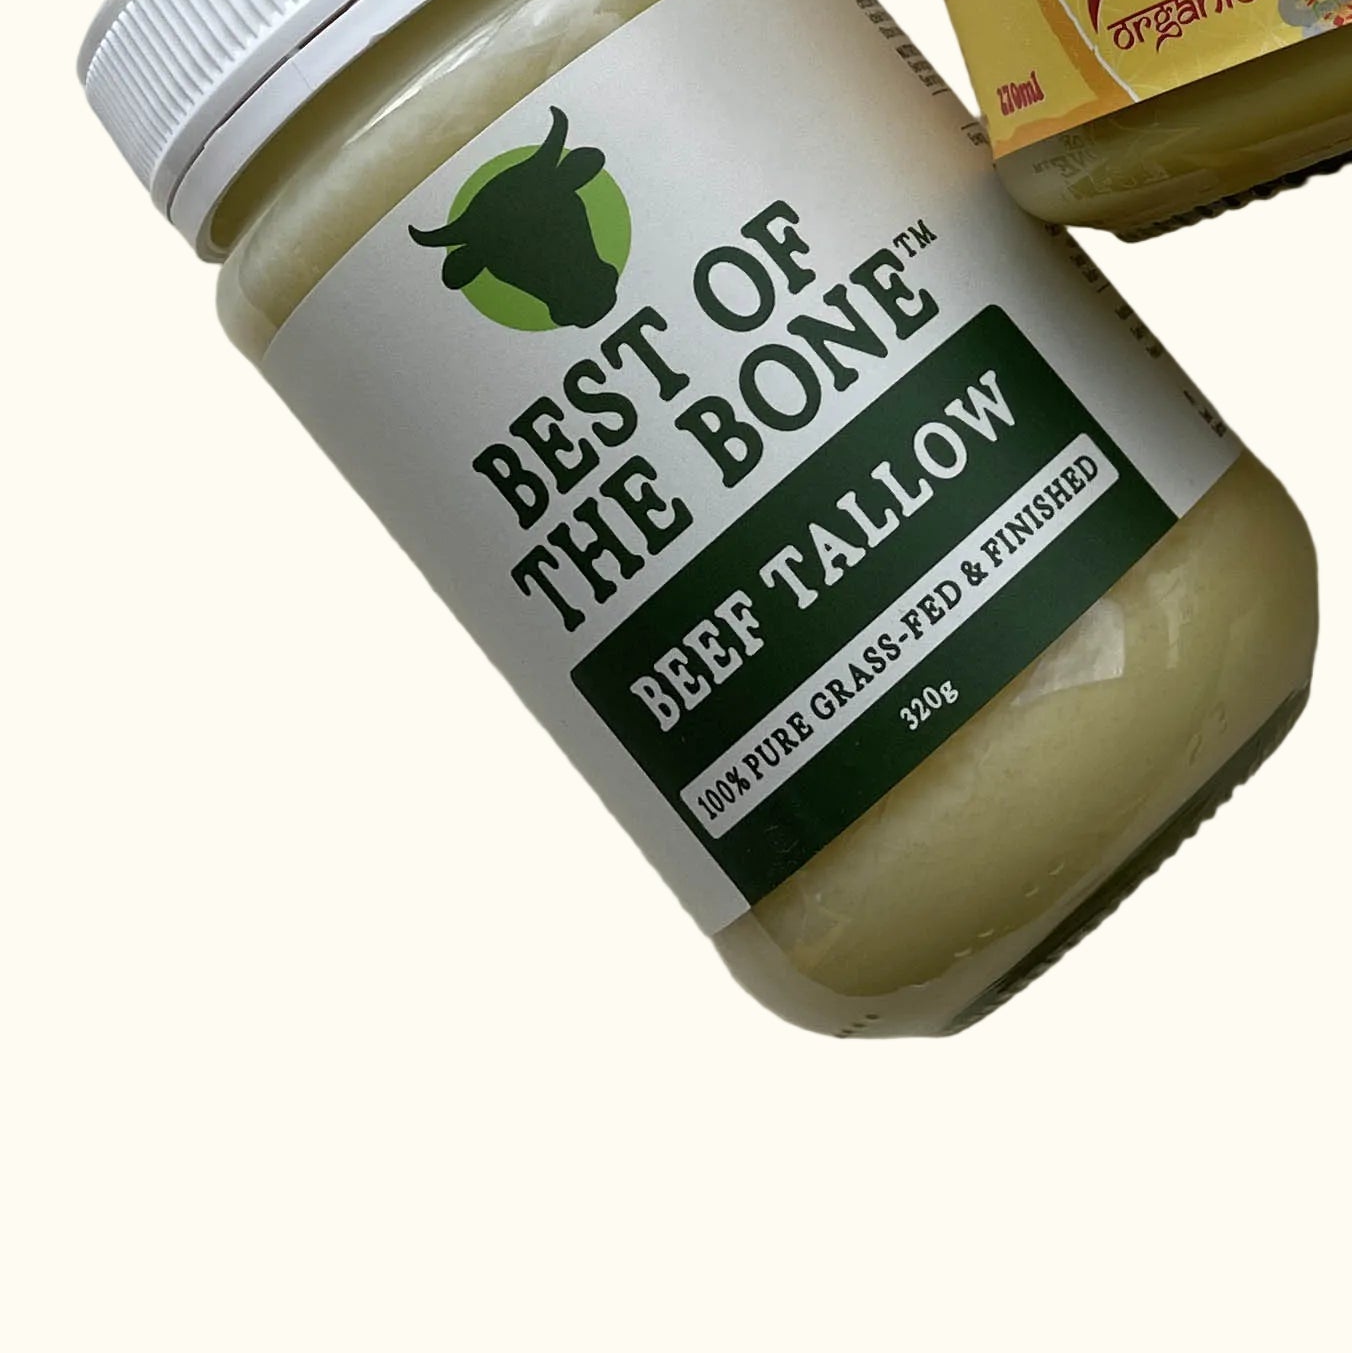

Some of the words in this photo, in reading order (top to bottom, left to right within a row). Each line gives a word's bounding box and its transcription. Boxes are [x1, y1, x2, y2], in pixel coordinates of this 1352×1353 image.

[472, 306, 690, 530] BEST
[693, 199, 816, 333] OF
[511, 455, 694, 633] THE
[629, 589, 764, 732] BEEF
[759, 369, 1016, 610] TALLOW
[696, 766, 751, 821] 100%
[742, 711, 814, 780] PURE
[809, 578, 963, 720] GRASS-FED
[959, 559, 989, 586] &
[979, 453, 1100, 568] FINISHED
[899, 680, 960, 731] 320g
